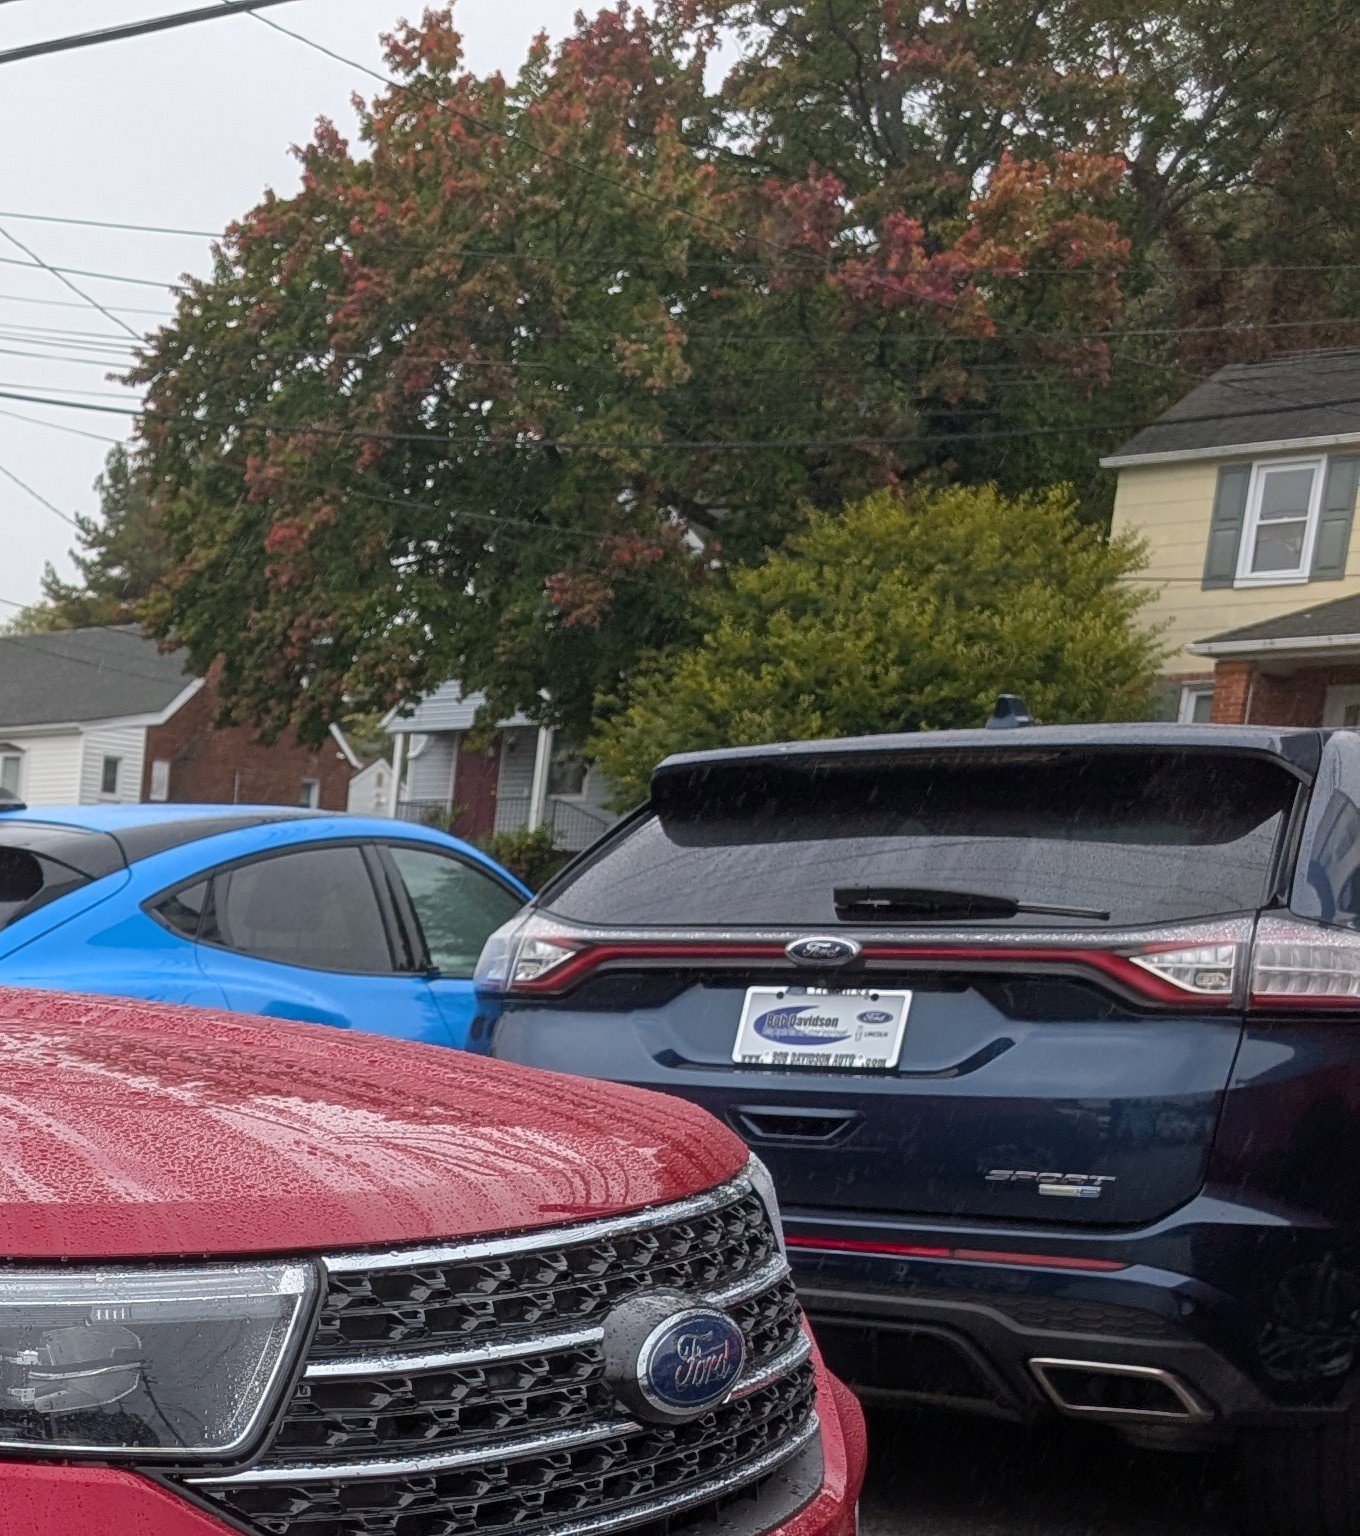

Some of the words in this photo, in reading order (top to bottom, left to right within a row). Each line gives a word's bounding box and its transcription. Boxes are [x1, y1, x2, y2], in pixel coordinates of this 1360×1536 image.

[788, 1013, 839, 1029] Davidson
[985, 1169, 1117, 1186] SPORT
[674, 1330, 731, 1392] Ford
